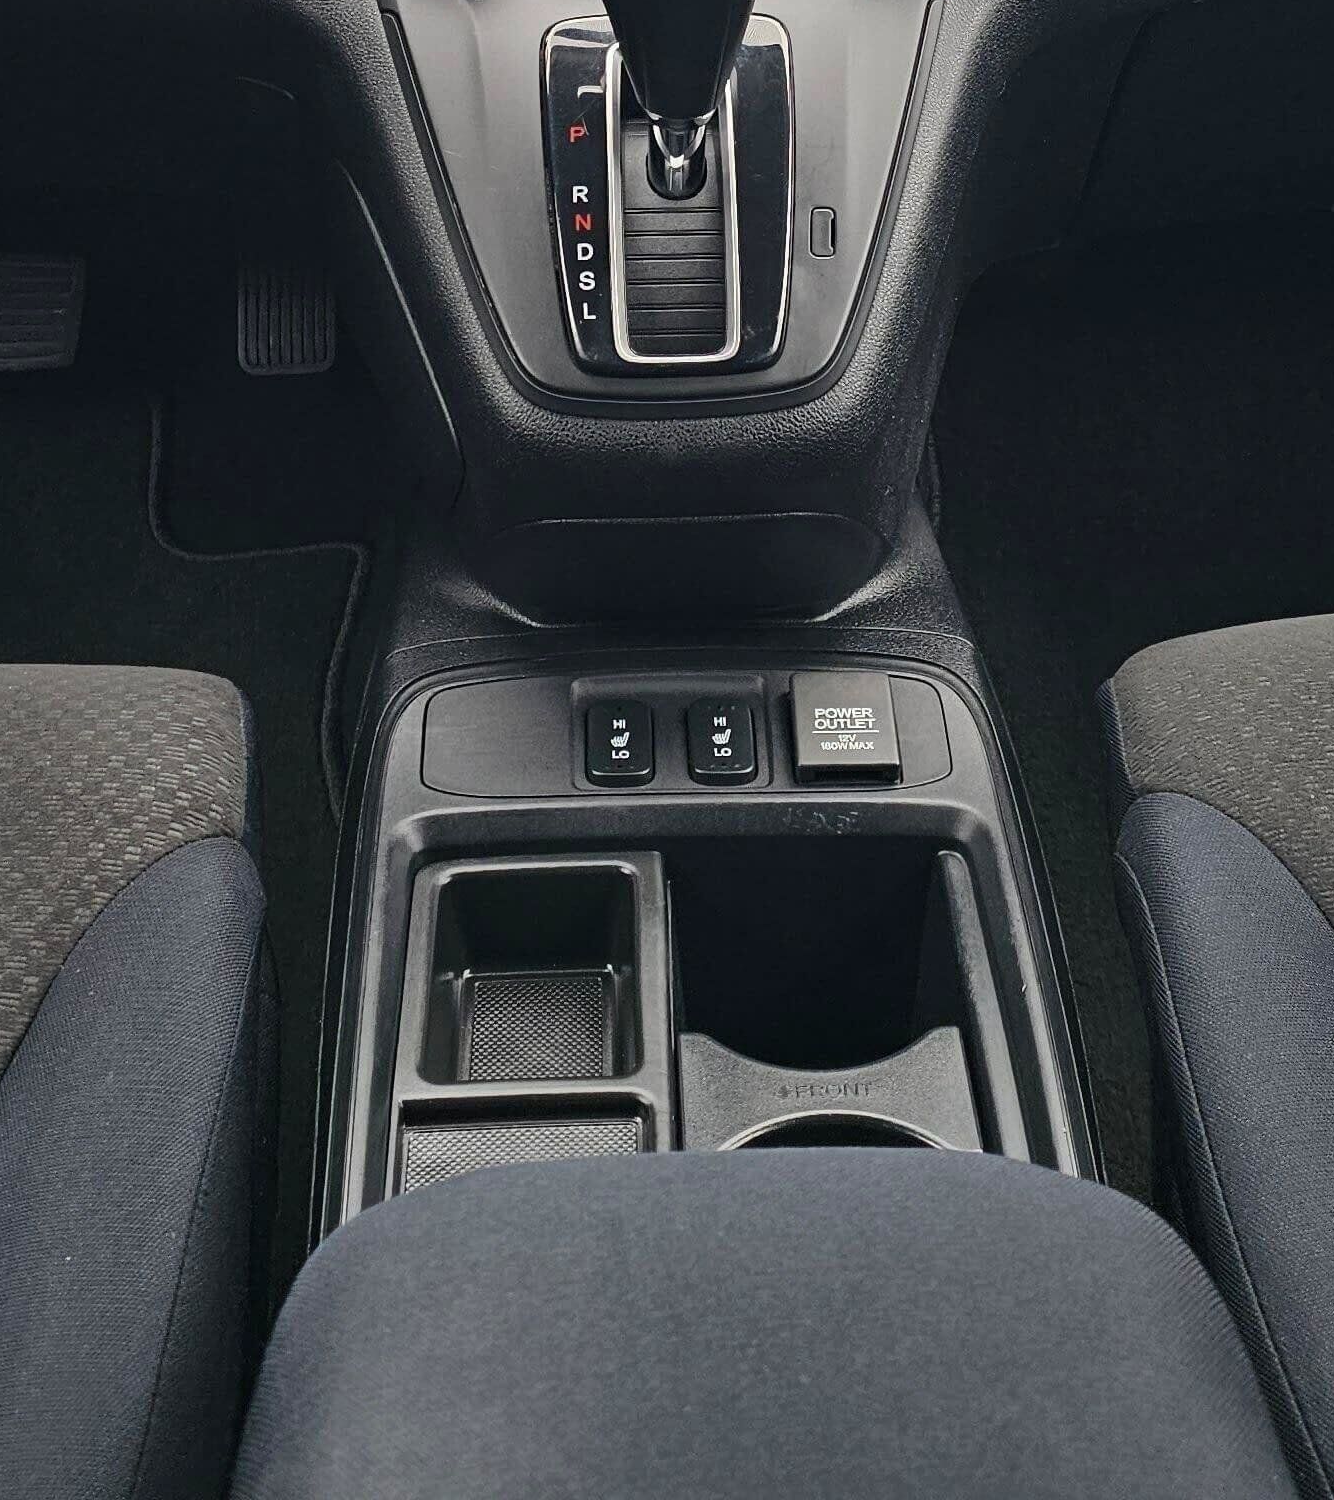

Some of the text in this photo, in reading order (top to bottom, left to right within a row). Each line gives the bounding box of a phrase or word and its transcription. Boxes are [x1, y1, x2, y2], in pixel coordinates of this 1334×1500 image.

[570, 126, 586, 143] P
[572, 186, 589, 204] R
[575, 214, 592, 231] N
[576, 242, 594, 261] D
[578, 271, 596, 291] S
[583, 302, 597, 320] L
[814, 707, 873, 719] POWER
[612, 719, 626, 730] HI
[713, 716, 727, 727] HI
[814, 718, 875, 730] OUTLET
[838, 733, 857, 742] 12V
[848, 741, 875, 750] MAX
[611, 750, 630, 759] LO
[713, 747, 733, 757] LO
[795, 1082, 873, 1098] FRONT
